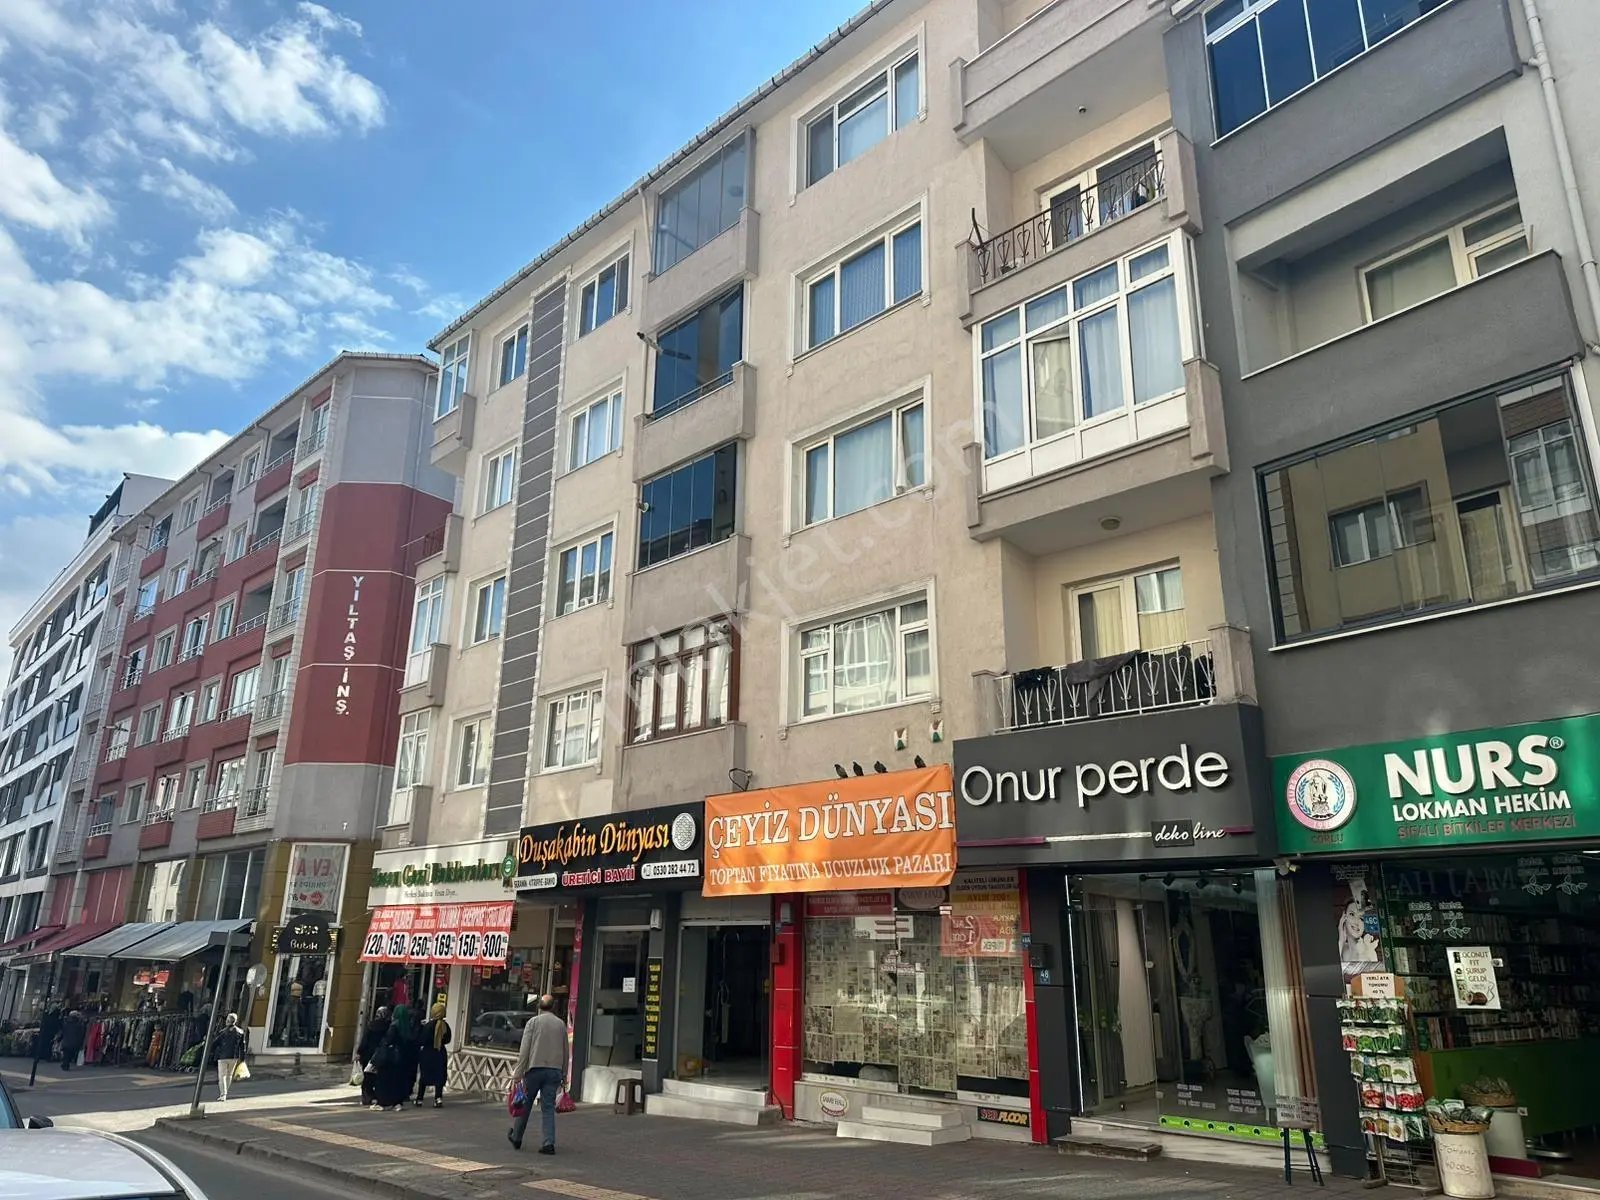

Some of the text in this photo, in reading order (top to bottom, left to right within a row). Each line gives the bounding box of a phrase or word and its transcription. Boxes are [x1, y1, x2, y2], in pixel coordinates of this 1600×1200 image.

[960, 743, 1229, 808] Onur perde
[1392, 787, 1572, 823] LOKMAN HEKİM
[708, 791, 955, 860] ÇEYİZ DÜNYASI
[1154, 822, 1226, 843] deko line
[1511, 812, 1577, 832] MERKEZİ
[520, 820, 670, 872] Duşakabin Dünyası
[561, 864, 636, 887] ÜRETİCİ BAYİİ
[652, 865, 667, 876] 0530
[679, 863, 687, 874] 44
[709, 865, 757, 886] TOPTAN
[822, 856, 892, 879] UCUZLUK
[893, 852, 953, 875] PAZARI
[365, 933, 384, 956] 120
[388, 933, 406, 956] 150
[410, 935, 428, 957] 250
[434, 934, 451, 957] 169
[458, 934, 476, 958] 150
[482, 934, 501, 958] 300
